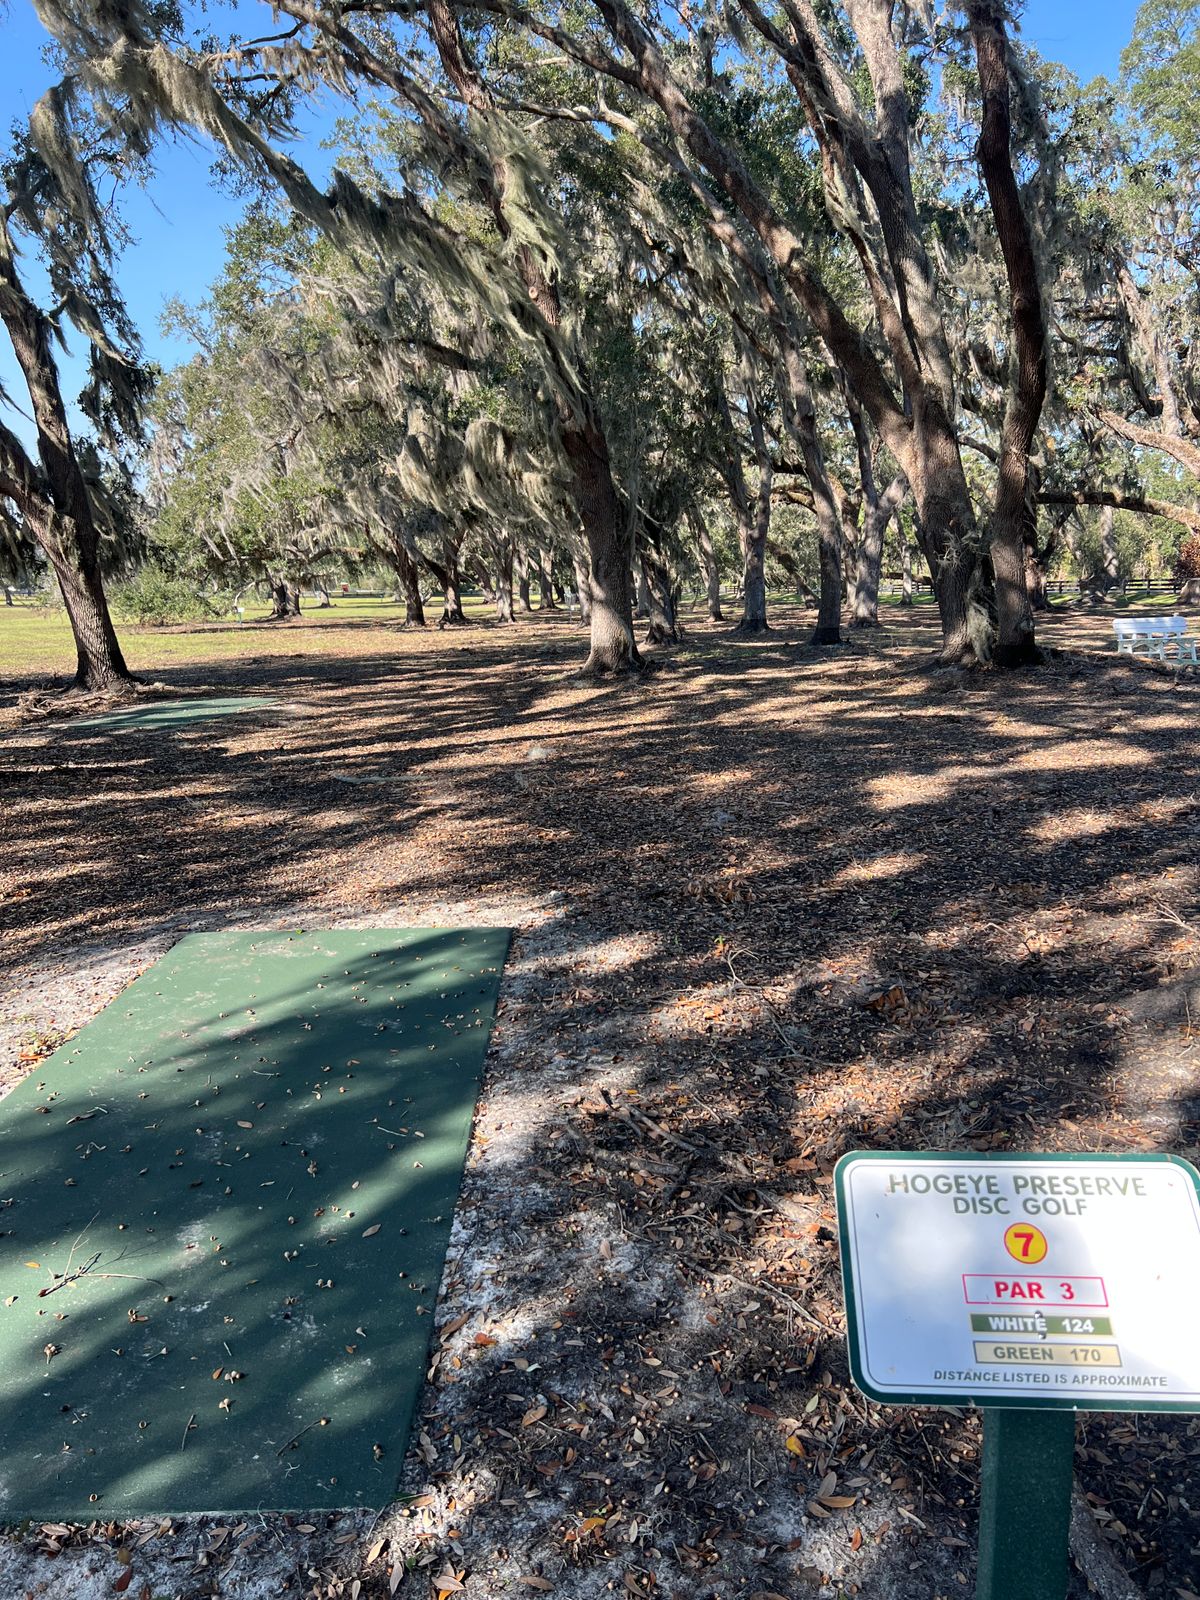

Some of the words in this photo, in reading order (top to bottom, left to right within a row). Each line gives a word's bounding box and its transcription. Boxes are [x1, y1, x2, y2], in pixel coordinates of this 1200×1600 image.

[888, 1173, 999, 1195] HOGEYE
[1013, 1174, 1147, 1197] PRESERVE
[953, 1197, 1011, 1215] DISC
[1022, 1197, 1088, 1216] GOLF
[1013, 1232, 1034, 1257] 7
[994, 1281, 1045, 1299] PAR
[1059, 1282, 1075, 1300] 3
[988, 1316, 1048, 1332] WHITE
[1062, 1319, 1095, 1333] 124
[993, 1346, 1054, 1361] GREEN
[1070, 1348, 1101, 1362] 170
[933, 1370, 1001, 1383] DISTANCE
[1003, 1371, 1050, 1384] LISTED
[1055, 1373, 1068, 1385] IS
[1071, 1374, 1168, 1387] APPROXIMATE
